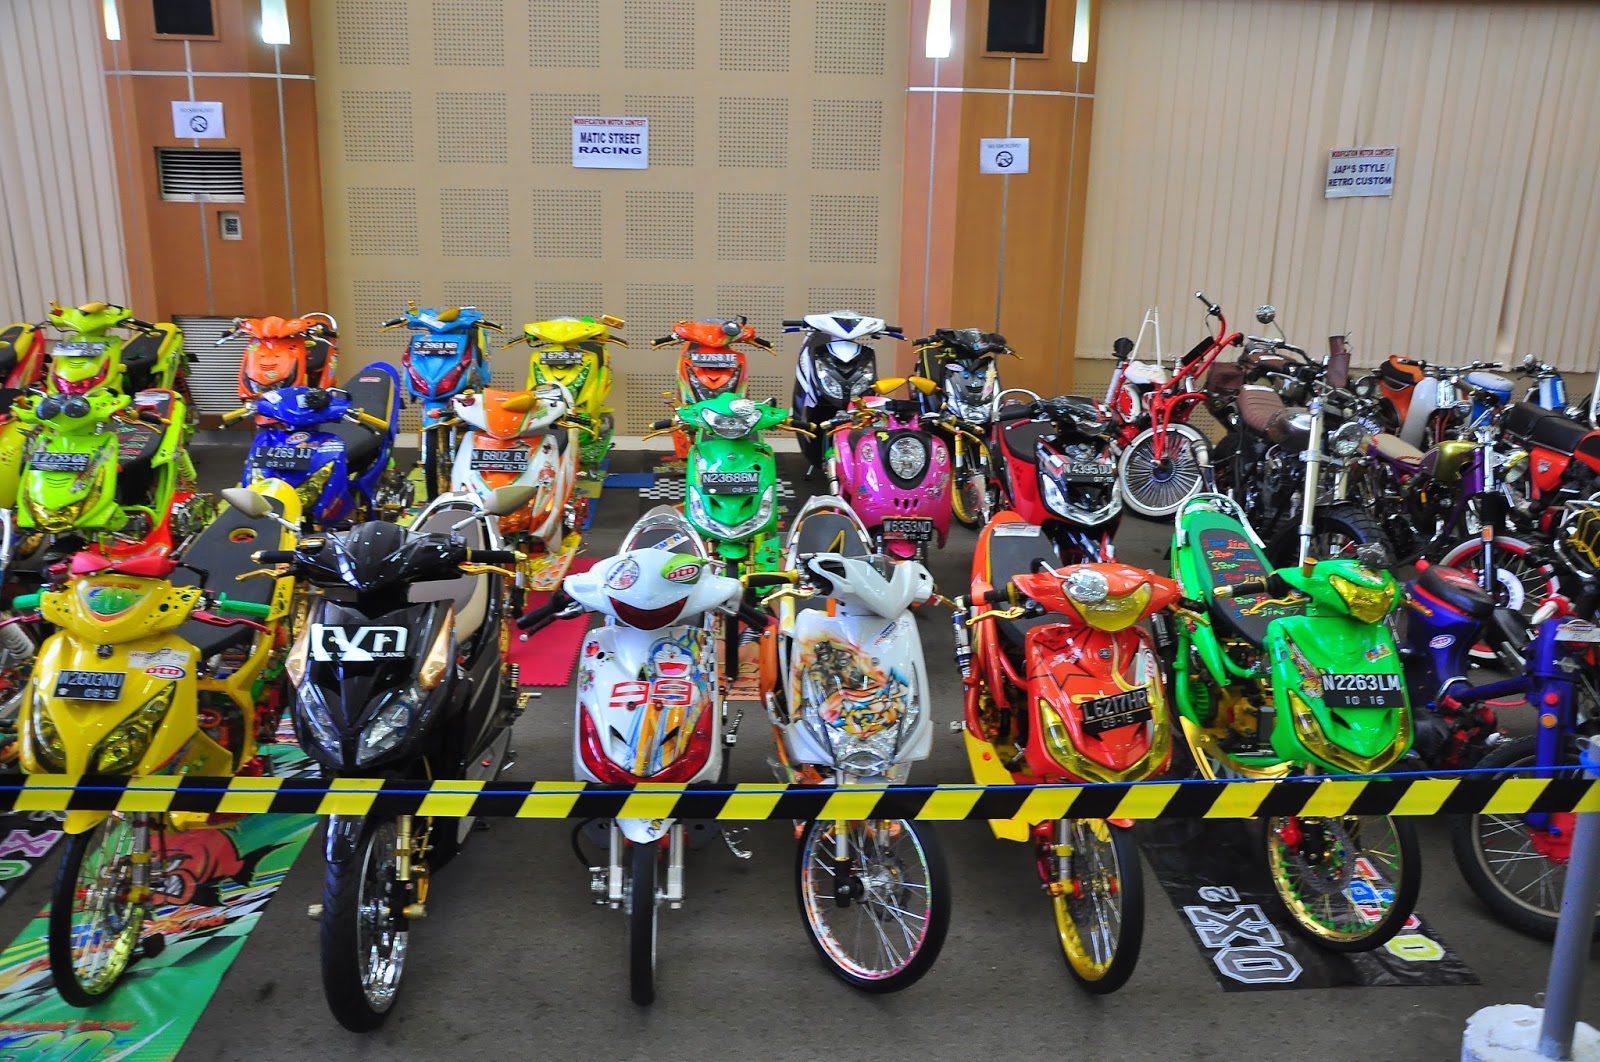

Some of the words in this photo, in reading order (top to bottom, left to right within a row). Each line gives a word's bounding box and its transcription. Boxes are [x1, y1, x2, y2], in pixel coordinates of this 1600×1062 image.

[580, 132, 606, 144] MATIC
[608, 132, 640, 145] STREET
[578, 146, 642, 155] RACING
[1358, 163, 1385, 173] STYLE
[1328, 178, 1354, 187] RETRO
[1355, 176, 1392, 186] CUSTOM
[255, 447, 263, 458] L
[266, 447, 295, 458] 4269
[296, 448, 312, 459] JJ
[482, 450, 510, 461] 6802
[1322, 674, 1402, 691] N2263LM
